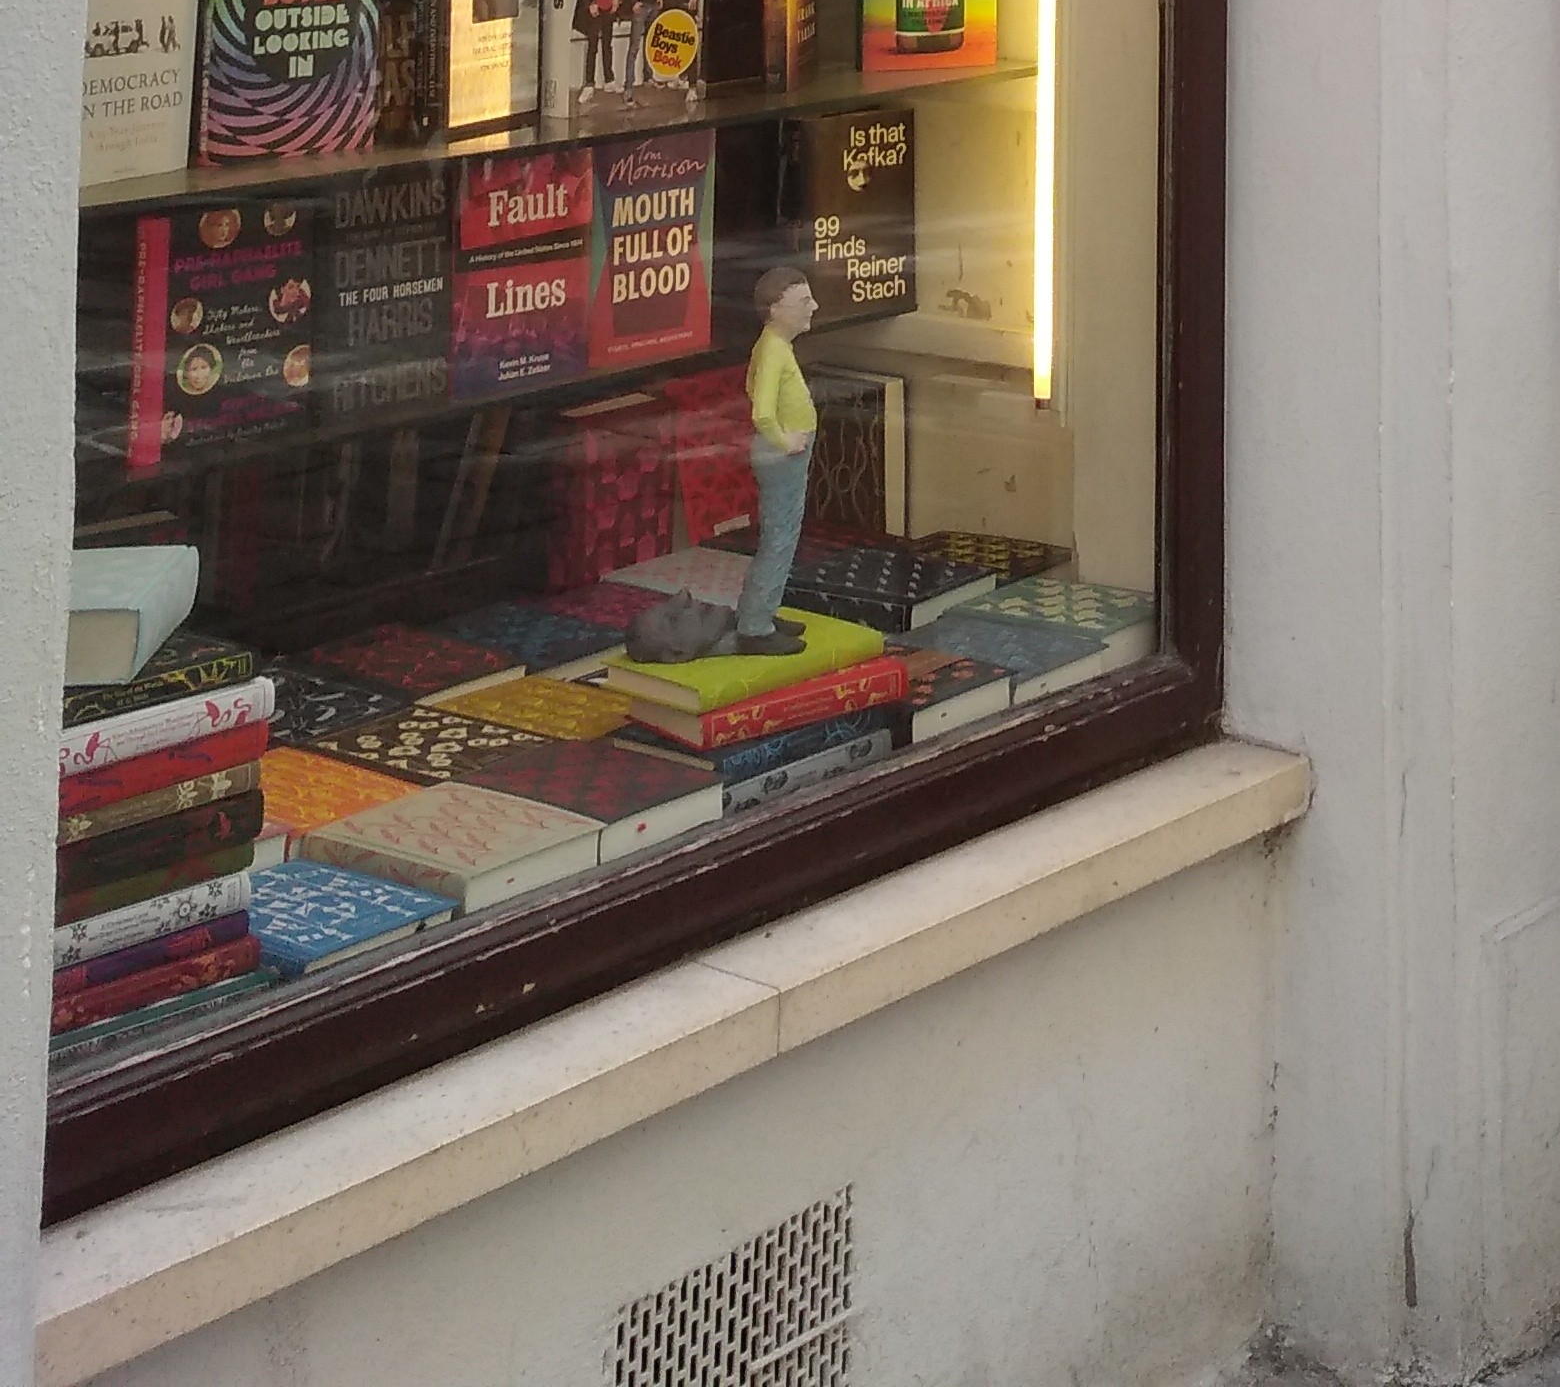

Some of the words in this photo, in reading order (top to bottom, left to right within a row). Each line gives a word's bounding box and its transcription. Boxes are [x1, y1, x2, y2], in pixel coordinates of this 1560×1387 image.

[254, 3, 350, 32] OUTSIDE
[253, 29, 350, 56] LOOKING
[650, 35, 679, 54] Boys
[655, 23, 696, 47] Beastie
[288, 54, 314, 79] IN
[652, 52, 682, 70] Book
[102, 98, 135, 117] THE
[140, 90, 183, 111] ROAD
[850, 126, 866, 148] Is
[868, 123, 905, 145] that
[607, 152, 707, 187] Morrison
[334, 178, 446, 229] DAWKINS
[487, 183, 569, 228] Fault
[612, 187, 695, 227] MOUTH
[814, 215, 840, 238] 99
[469, 254, 475, 264] A
[475, 251, 497, 263] History
[503, 249, 514, 258] the
[613, 232, 663, 266] FULL
[666, 224, 694, 257] OF
[815, 235, 866, 262] Finds
[334, 236, 446, 289] DENNETT
[847, 255, 907, 280] Reiner
[339, 291, 359, 307] THE
[363, 285, 389, 303] FOUR
[393, 277, 443, 298] HORSEMEN
[612, 262, 691, 304] BLOOD
[852, 275, 906, 303] Stach
[485, 278, 566, 319] Lines
[349, 297, 433, 347] HARRIS
